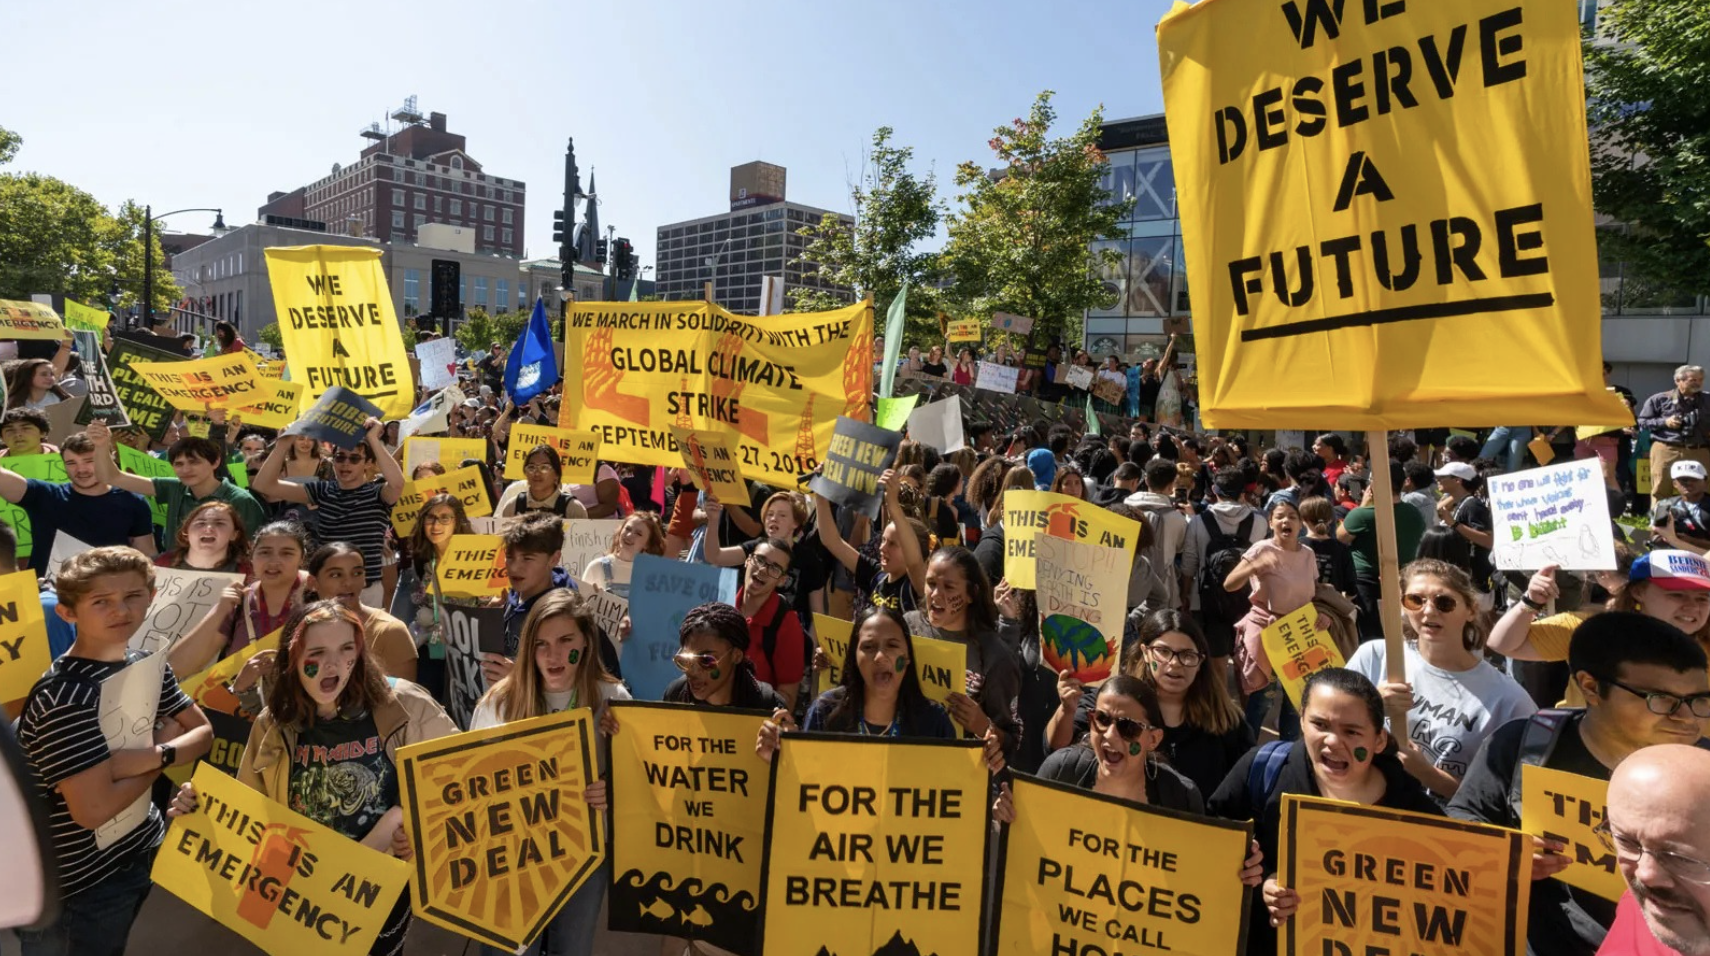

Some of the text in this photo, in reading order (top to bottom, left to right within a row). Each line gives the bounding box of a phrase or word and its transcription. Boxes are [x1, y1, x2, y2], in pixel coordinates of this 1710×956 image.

[1214, 6, 1527, 164] DESERVE
[1333, 151, 1395, 212] A
[1228, 203, 1549, 316] FUTURE
[306, 275, 343, 296] WE
[289, 303, 381, 330] DESERVE
[572, 312, 852, 348] WE MARCH IN SOLIDARITY WITH THE
[333, 338, 350, 358] A
[147, 364, 247, 384] THIS IS AN
[307, 363, 397, 389] FUTURE
[611, 347, 803, 390] GLOBAL CLIMATE
[132, 393, 167, 410] CALL
[161, 380, 256, 399] EMERGENCY
[277, 389, 295, 400] AN
[667, 391, 740, 424] STRIKE
[560, 439, 570, 449] IS
[578, 441, 594, 451] AN
[590, 424, 679, 452] SEPTEMB
[713, 447, 730, 460] AN
[856, 441, 888, 467] NEW
[399, 493, 423, 506] HIS
[458, 479, 477, 492] AN
[1009, 510, 1125, 548] THIS IS AN
[454, 549, 496, 561] THIS
[187, 577, 213, 599] IS
[444, 568, 508, 580] EMERG
[1049, 596, 1101, 623] DYING
[1080, 591, 1100, 607] IS
[1297, 614, 1319, 648] THIS
[922, 664, 951, 689] AN
[654, 735, 737, 754] FOR THE
[441, 757, 558, 806] GREEN
[644, 760, 749, 796] WATER
[684, 800, 714, 817] WE
[799, 783, 963, 819] FOR THE
[444, 788, 561, 849] NEW
[202, 792, 382, 909] THIS IS AN
[655, 822, 745, 864] DRINK
[809, 832, 944, 865] AIR WE
[1069, 828, 1178, 872] FOR THE
[449, 830, 567, 890] DEAL
[1323, 849, 1469, 897] GREEN
[177, 829, 362, 945] EMERGENCY
[785, 875, 962, 911] BREATHE
[1037, 857, 1202, 925] PLACES
[1058, 903, 1098, 933] WE
[1105, 919, 1171, 950] CALL
[1322, 887, 1467, 947] NEW
